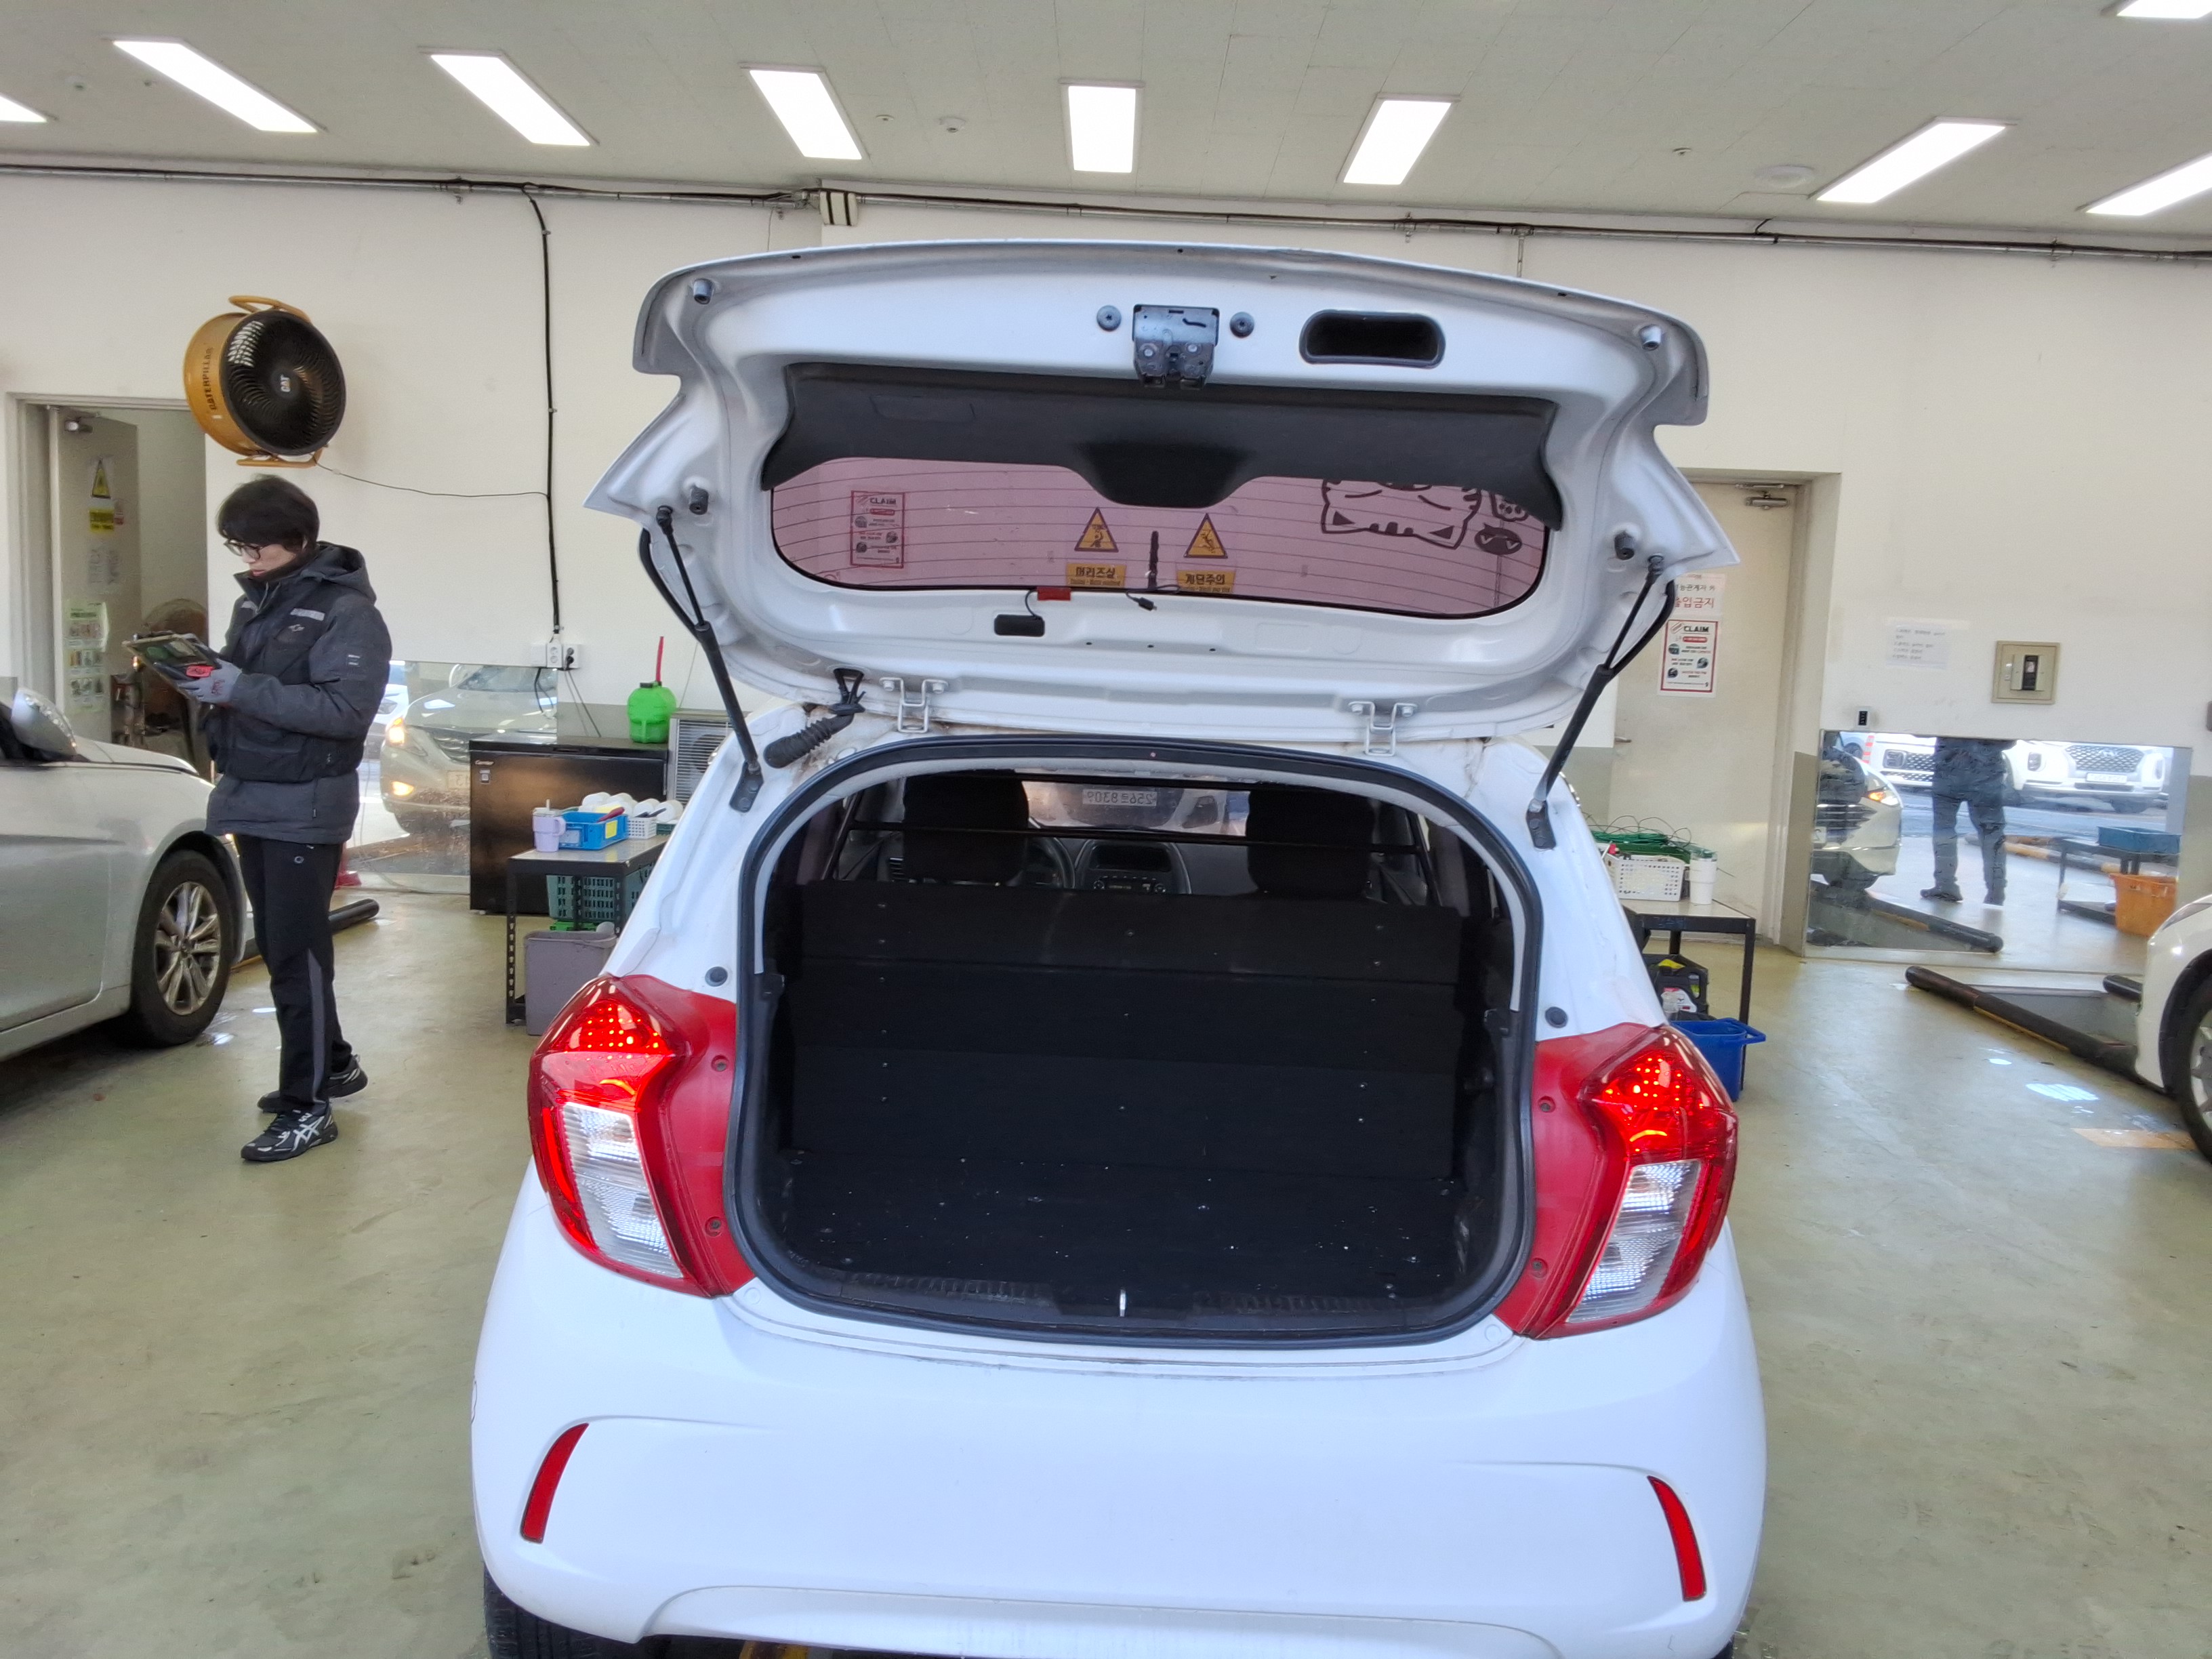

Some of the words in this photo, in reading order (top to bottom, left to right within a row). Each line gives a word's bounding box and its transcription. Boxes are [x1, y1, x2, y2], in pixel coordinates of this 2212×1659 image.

[280, 373, 291, 392] CAT
[1076, 567, 1115, 579] 머리조심
[1185, 573, 1225, 586] 계단주의
